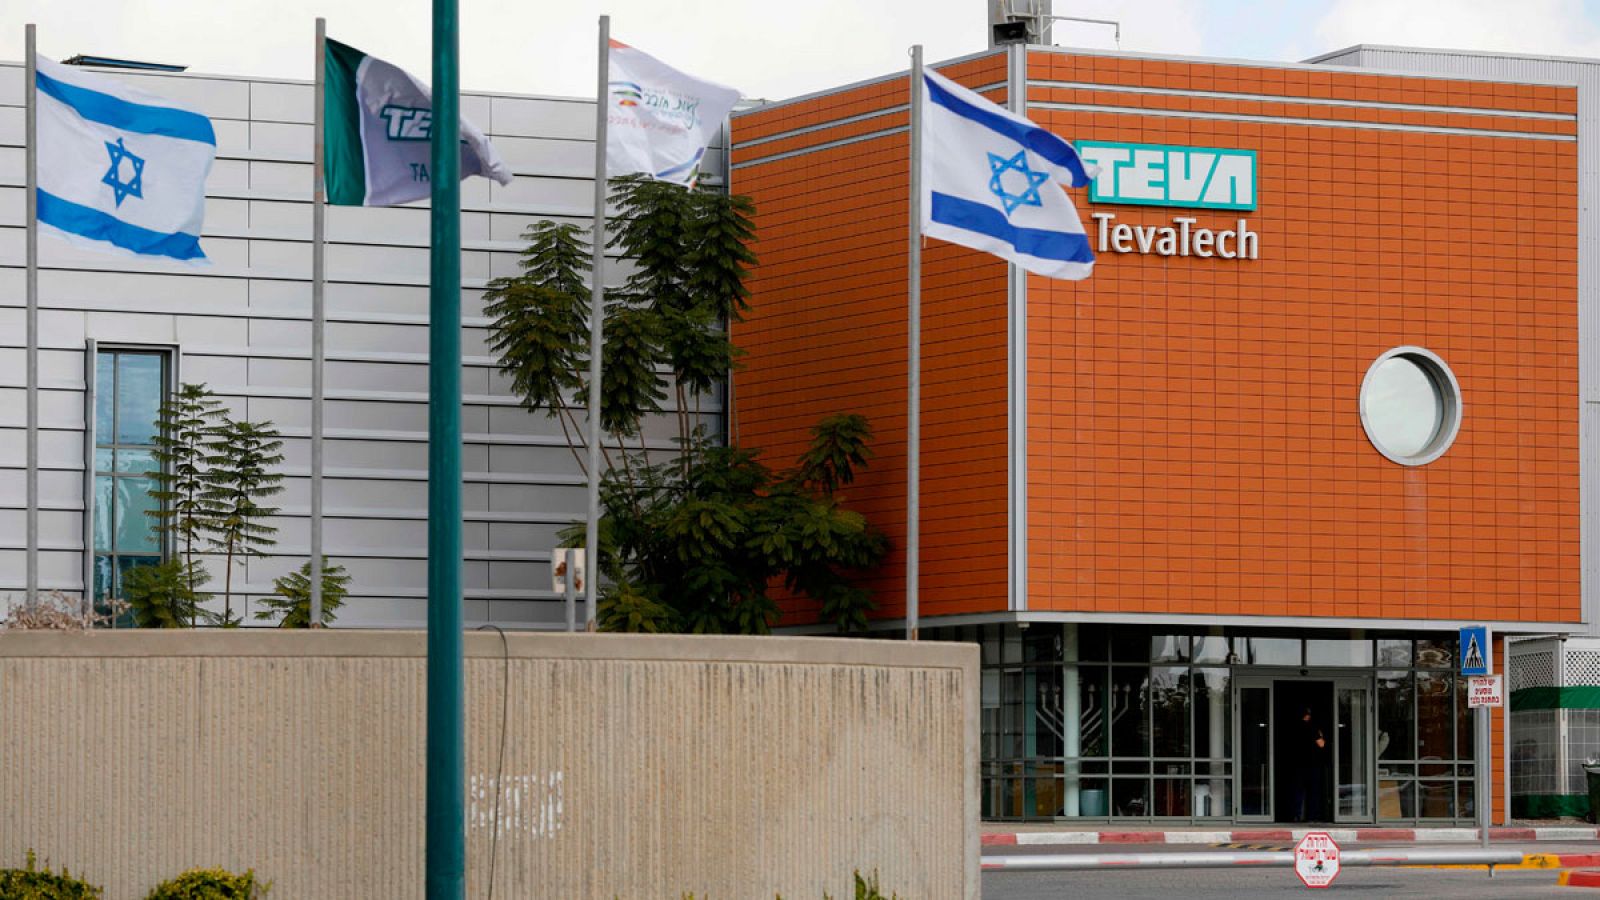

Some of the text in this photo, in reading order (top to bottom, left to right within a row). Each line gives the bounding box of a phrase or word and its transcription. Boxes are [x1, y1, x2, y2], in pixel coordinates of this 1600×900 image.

[382, 106, 432, 140] TE
[409, 163, 431, 182] TA
[1081, 146, 1253, 205] TEVA
[1091, 212, 1259, 260] TevaTech
